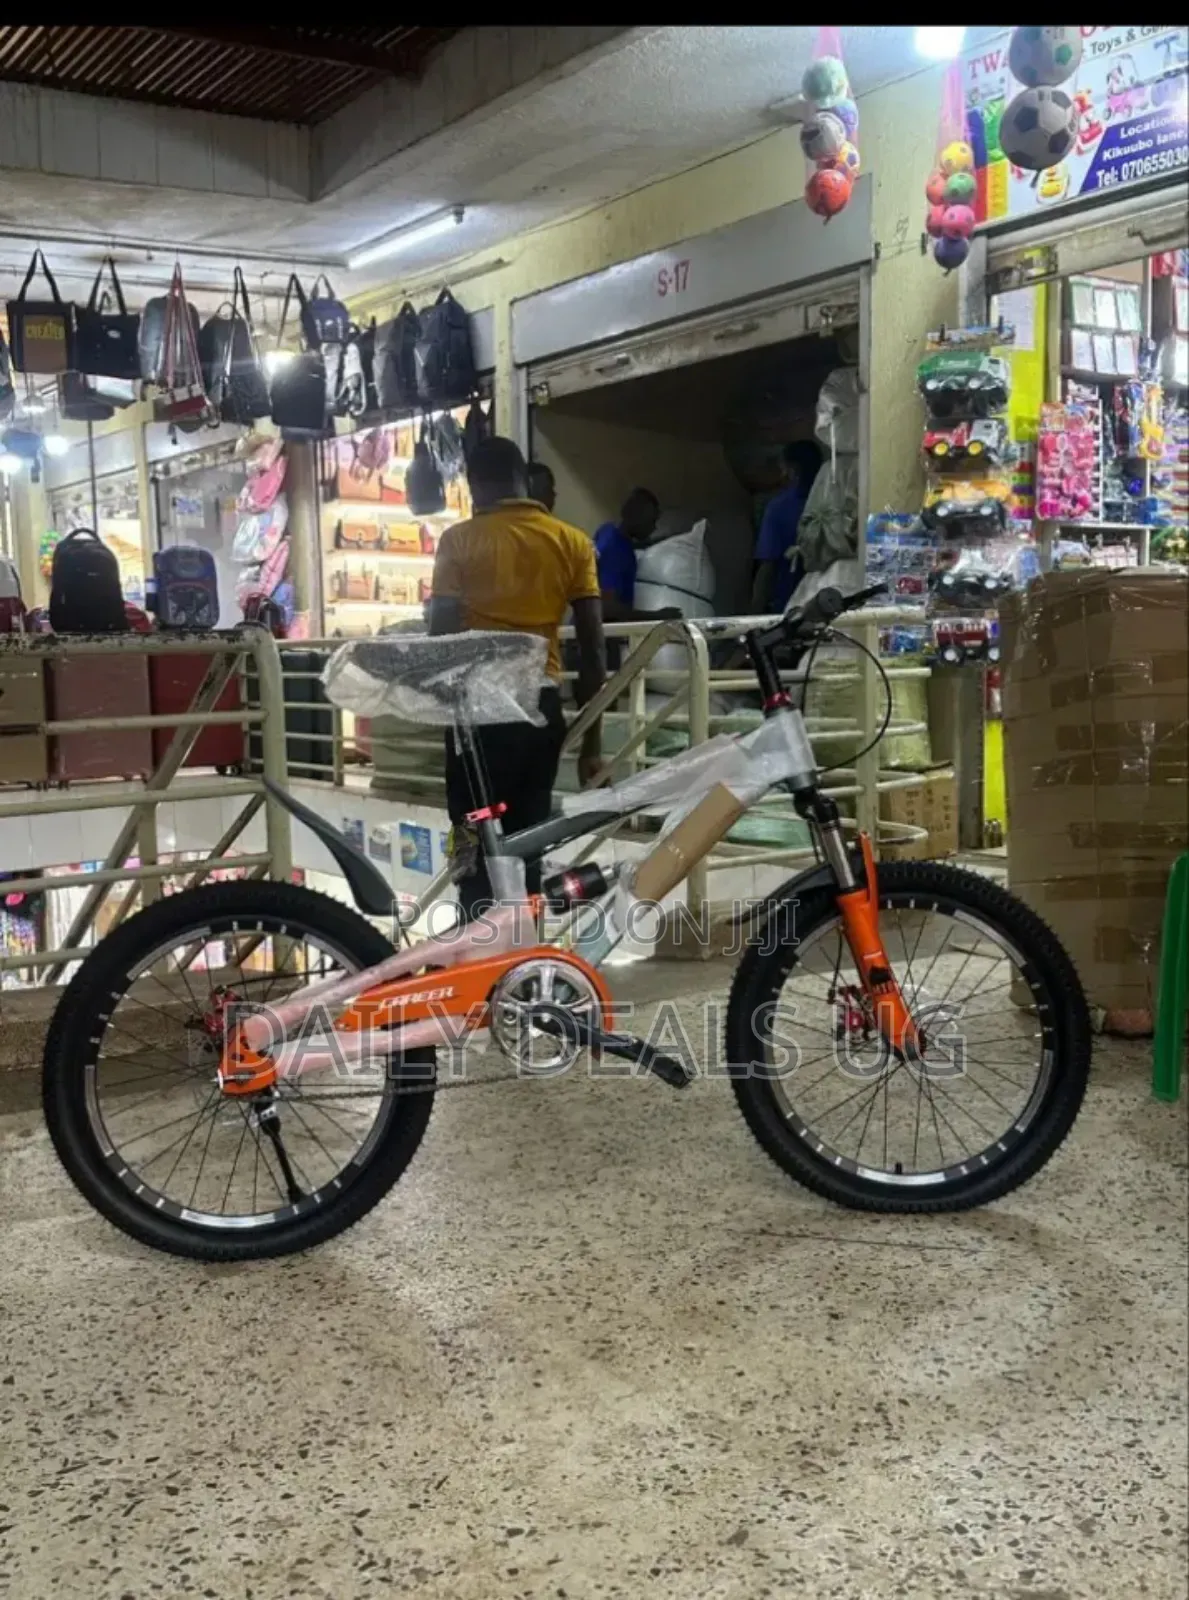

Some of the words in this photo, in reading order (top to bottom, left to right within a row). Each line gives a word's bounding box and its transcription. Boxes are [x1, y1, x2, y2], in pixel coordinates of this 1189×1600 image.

[1091, 36, 1122, 55] Toys
[1126, 27, 1136, 42] &
[1103, 139, 1153, 161] Kikuubo
[1096, 166, 1119, 188] Tel:
